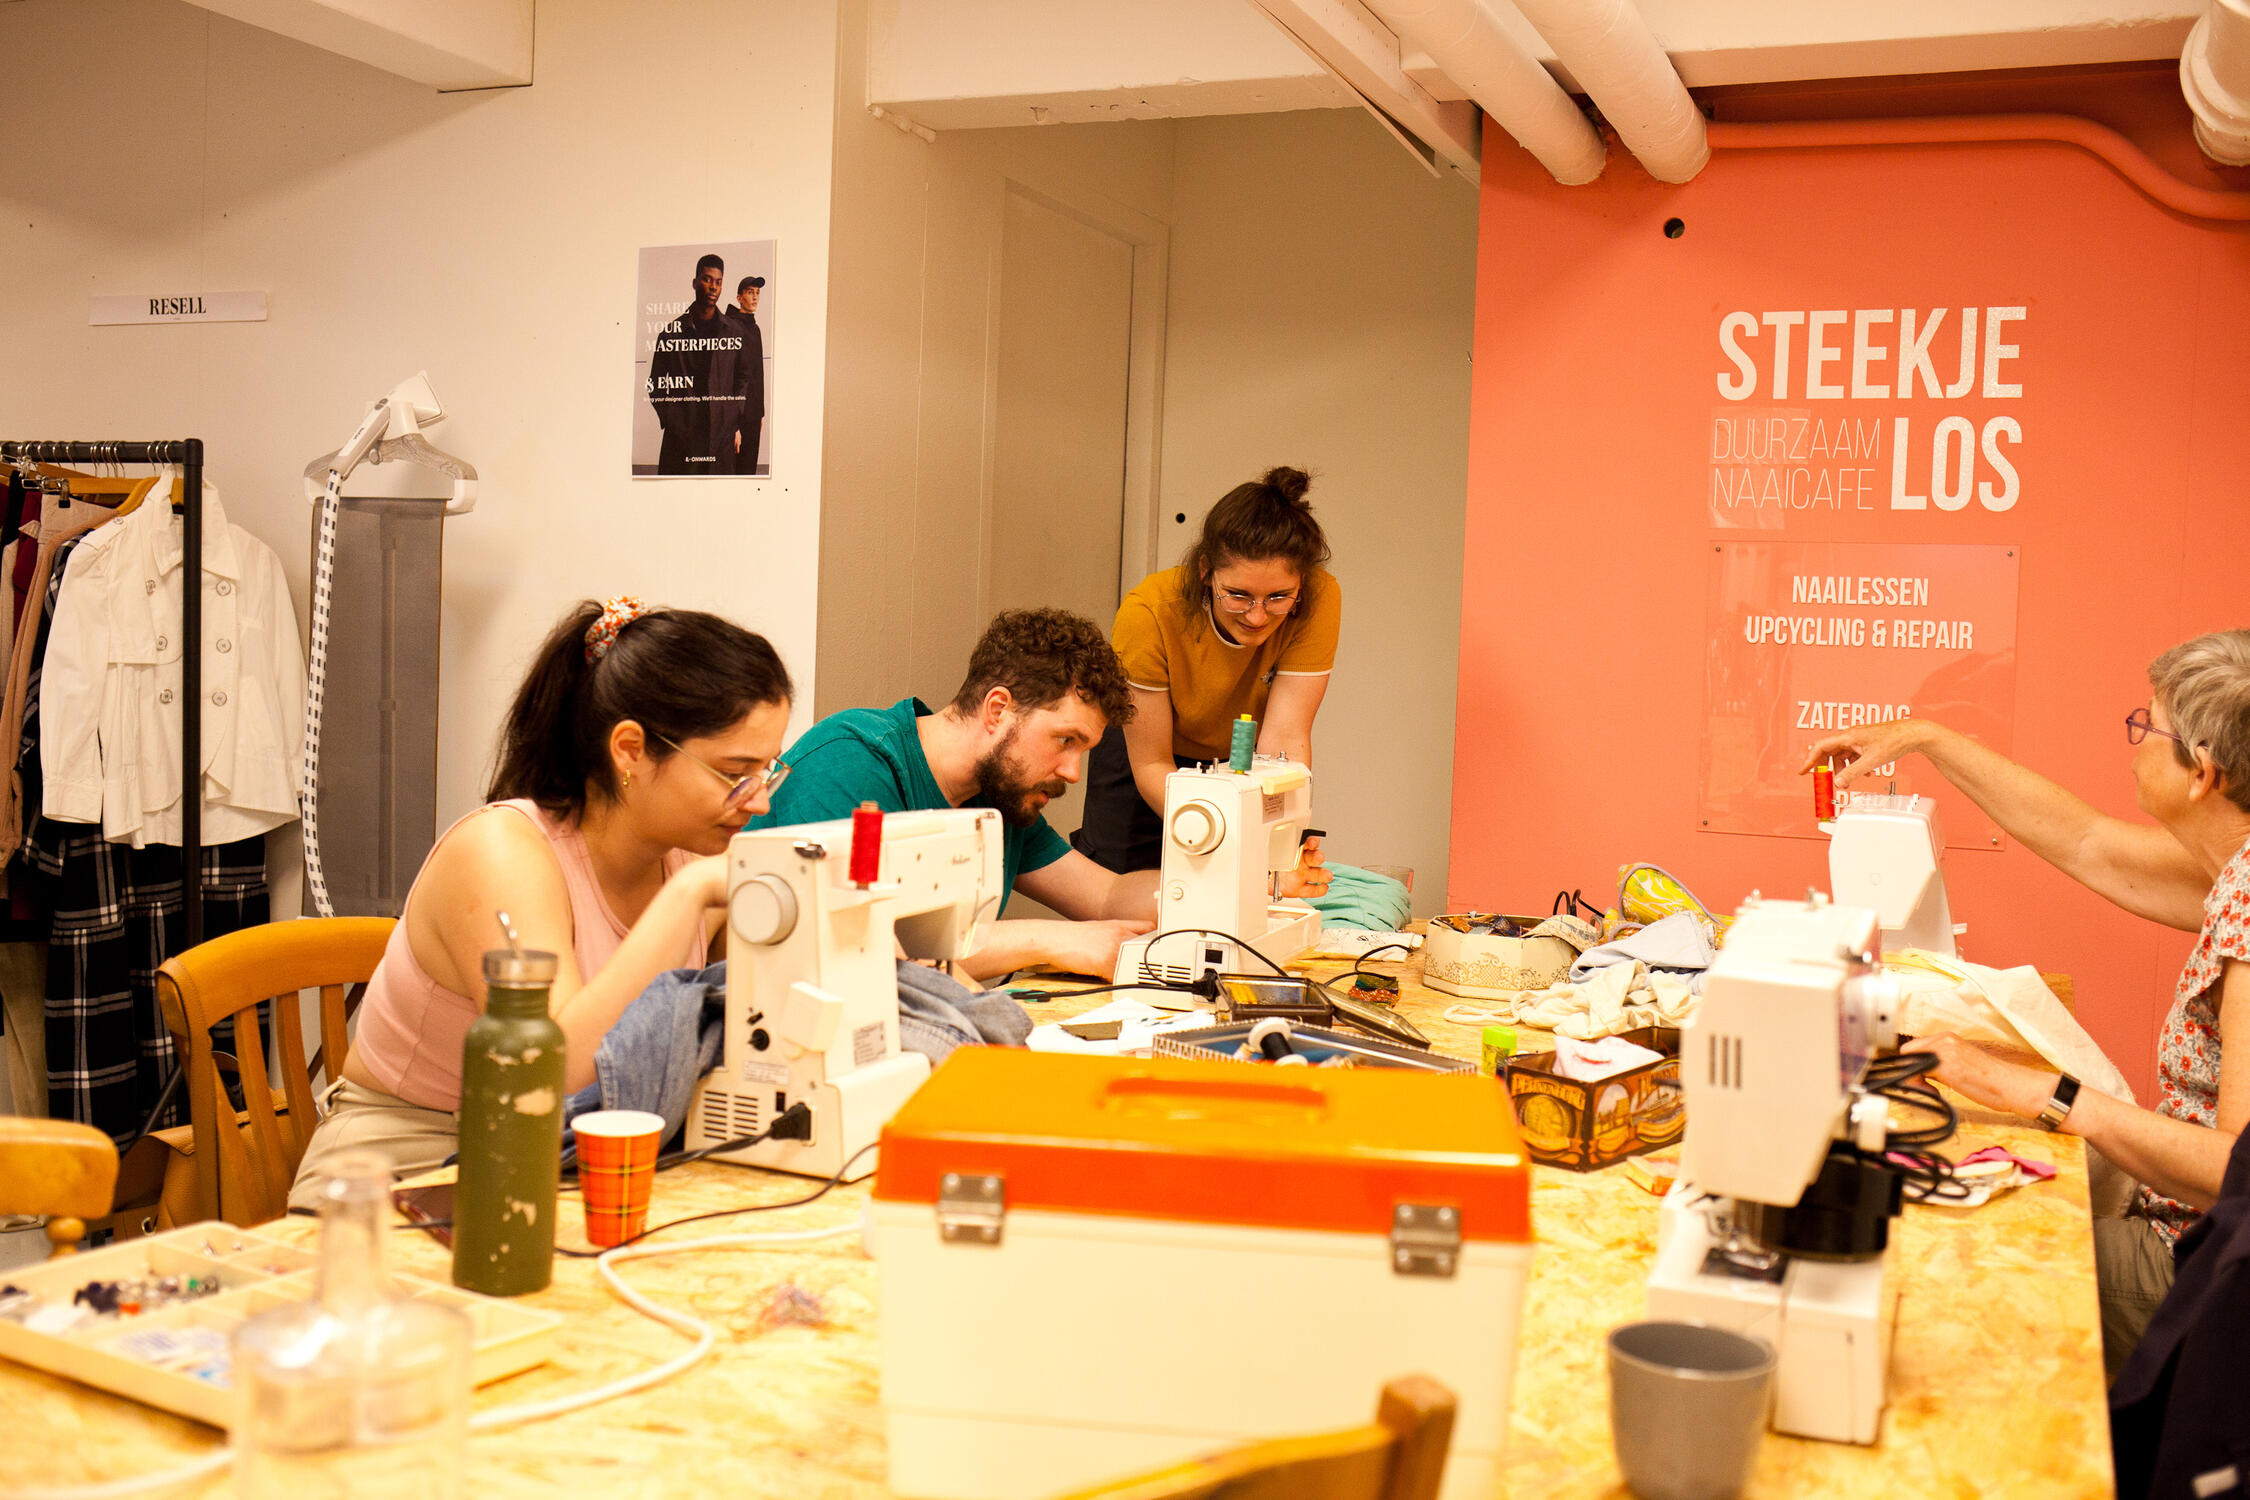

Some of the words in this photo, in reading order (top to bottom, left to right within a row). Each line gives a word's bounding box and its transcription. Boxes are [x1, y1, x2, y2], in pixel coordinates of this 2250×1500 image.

[149, 297, 207, 315] RESELL
[645, 302, 690, 315] SHARE
[646, 320, 682, 334] YOUR
[645, 337, 742, 353] MASTERPIECES
[1716, 306, 2027, 401] STEEKJE
[645, 377, 655, 393] &
[657, 375, 694, 389] EARN
[1713, 418, 1880, 460] DUURZAAM
[1891, 416, 2023, 512] LOS
[1713, 468, 1875, 510] NAAICAFE
[1792, 576, 1929, 606] NAAILESSEN
[1746, 616, 1865, 647] UPCYCLING
[1872, 620, 1887, 648] &
[1893, 620, 1974, 650] REPAIR
